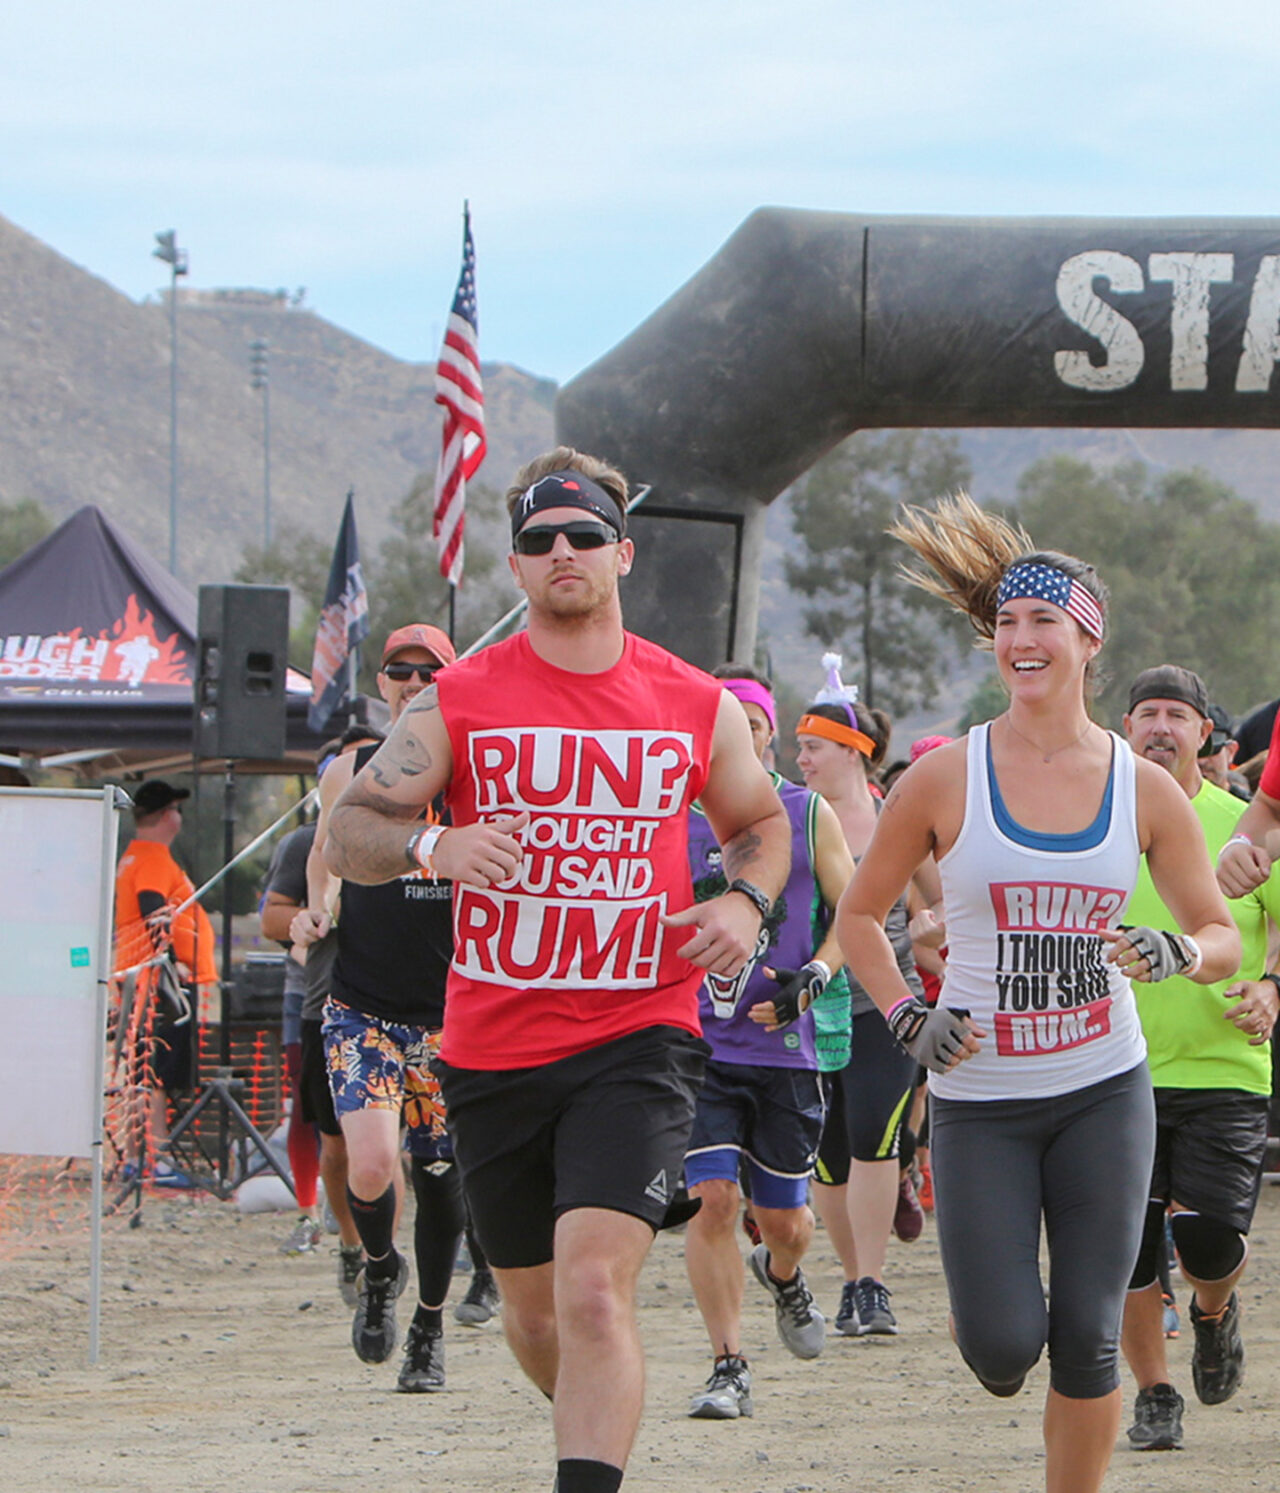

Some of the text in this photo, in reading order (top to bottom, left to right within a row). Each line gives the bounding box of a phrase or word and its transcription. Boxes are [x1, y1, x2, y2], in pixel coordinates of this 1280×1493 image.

[0, 635, 110, 666] UGH
[44, 688, 144, 697] CELSIUS
[473, 733, 692, 809] RUN?
[556, 856, 653, 898] SAID
[1004, 886, 1121, 930] RUN?
[455, 892, 660, 980] RUM!
[997, 934, 1004, 972] I
[996, 967, 1111, 1011] YOU SAID
